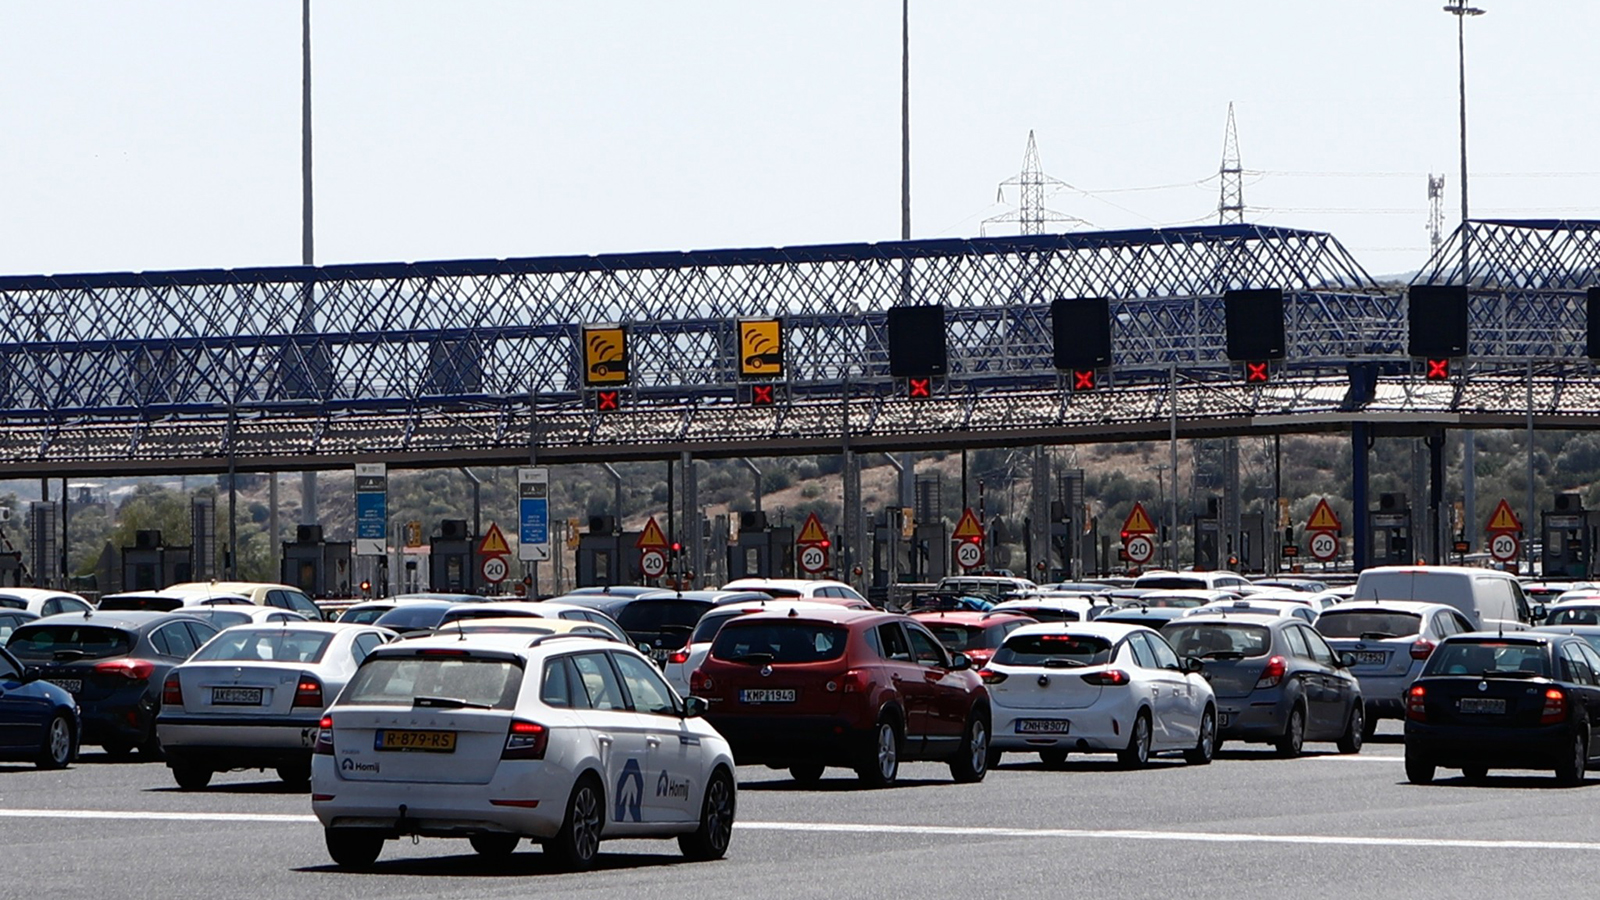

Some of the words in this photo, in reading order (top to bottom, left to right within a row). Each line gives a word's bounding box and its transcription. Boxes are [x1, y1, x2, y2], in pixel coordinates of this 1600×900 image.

[1130, 543, 1147, 555] 20
[1315, 540, 1332, 552] 20
[1495, 540, 1512, 552] 20
[805, 553, 821, 565] 20
[961, 548, 978, 560] 20
[645, 557, 661, 569] 20
[486, 564, 503, 575] 20
[387, 732, 450, 747] R-879-RS
[355, 762, 380, 774] Homij
